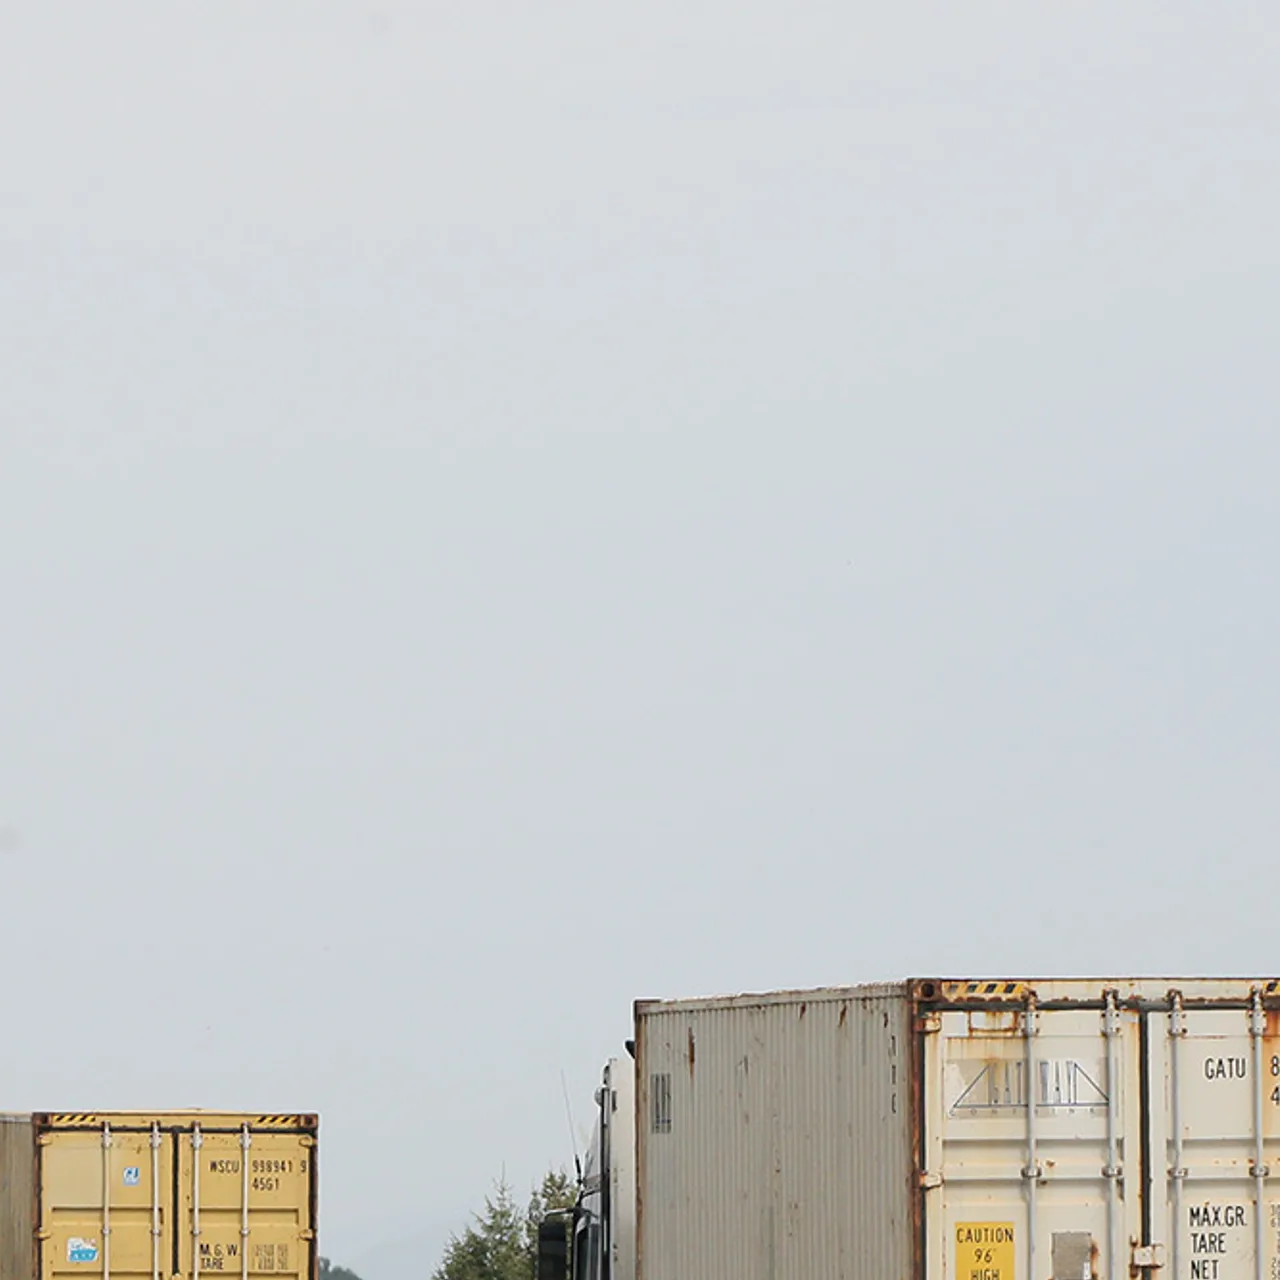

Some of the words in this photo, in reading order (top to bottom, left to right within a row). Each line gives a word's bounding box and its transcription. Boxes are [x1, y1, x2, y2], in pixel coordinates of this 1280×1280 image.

[1204, 1057, 1246, 1080] GATU
[252, 1177, 279, 1191] 45G1
[956, 1227, 1014, 1244] CAUTION
[1190, 1232, 1227, 1254] TARE
[200, 1257, 224, 1270] TARE
[1190, 1259, 1219, 1280] NET
